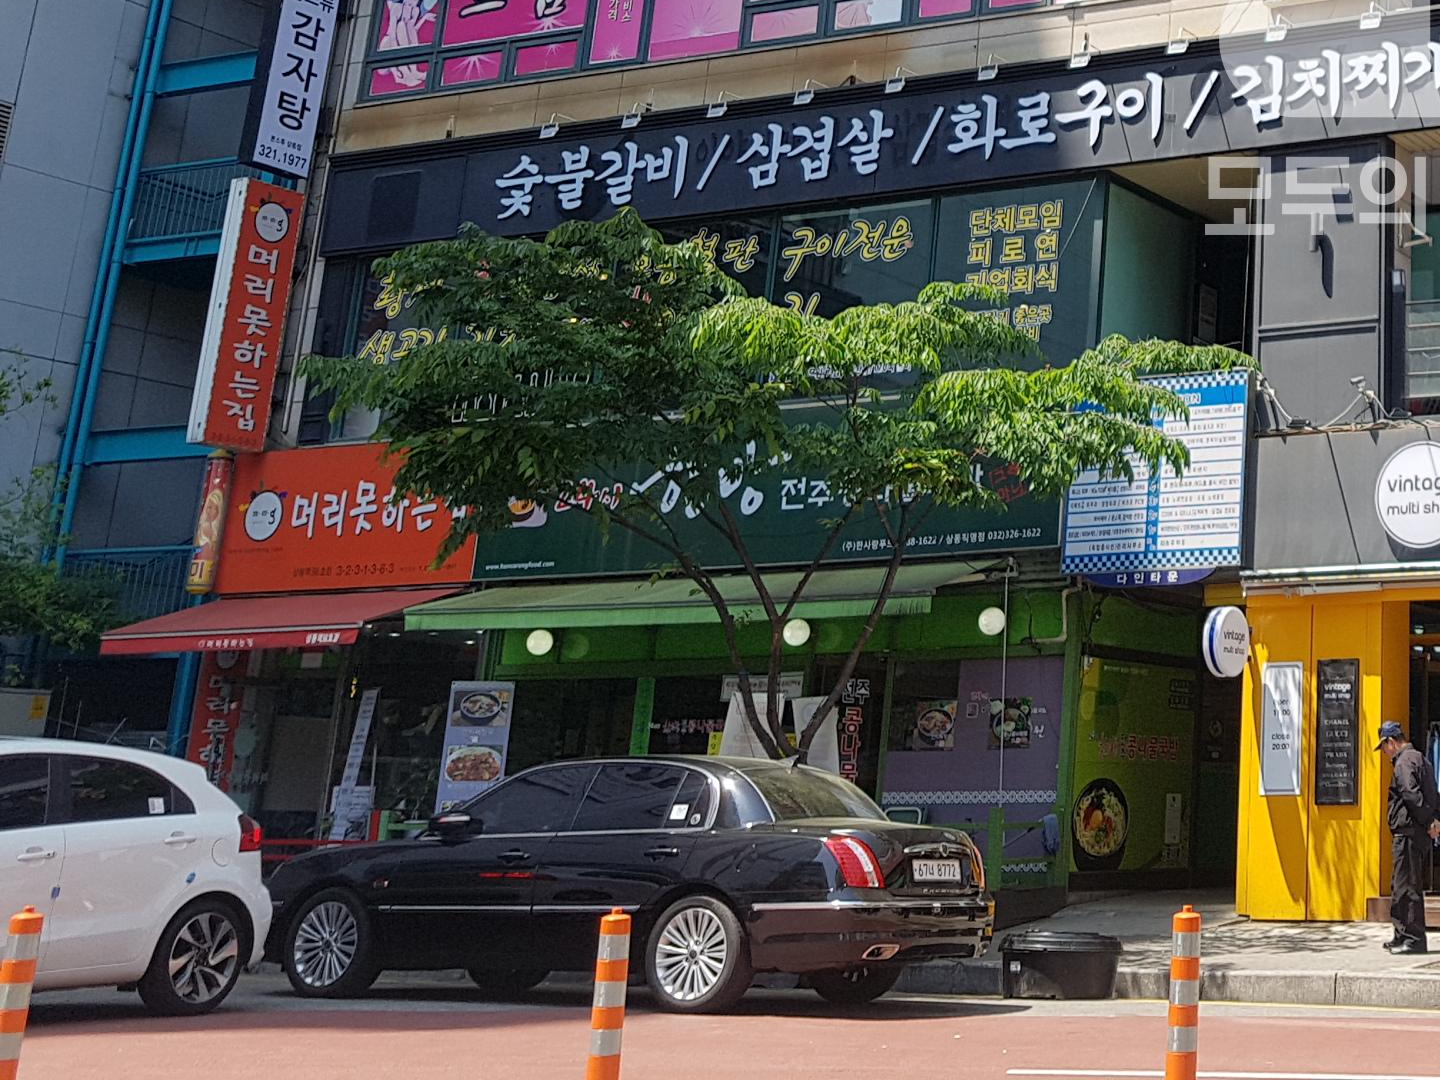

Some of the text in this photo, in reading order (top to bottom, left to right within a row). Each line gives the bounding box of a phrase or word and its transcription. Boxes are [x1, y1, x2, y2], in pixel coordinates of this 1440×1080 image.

[276, 11, 326, 132] 감자탕
[258, 144, 308, 170] 321.1977
[969, 200, 1065, 237] 단체모임
[967, 231, 1059, 266] 피로연
[222, 244, 280, 433] 머리못하는집
[781, 477, 832, 511] 전주
[1386, 500, 1420, 517] multi
[1117, 570, 1180, 586] 다인타운
